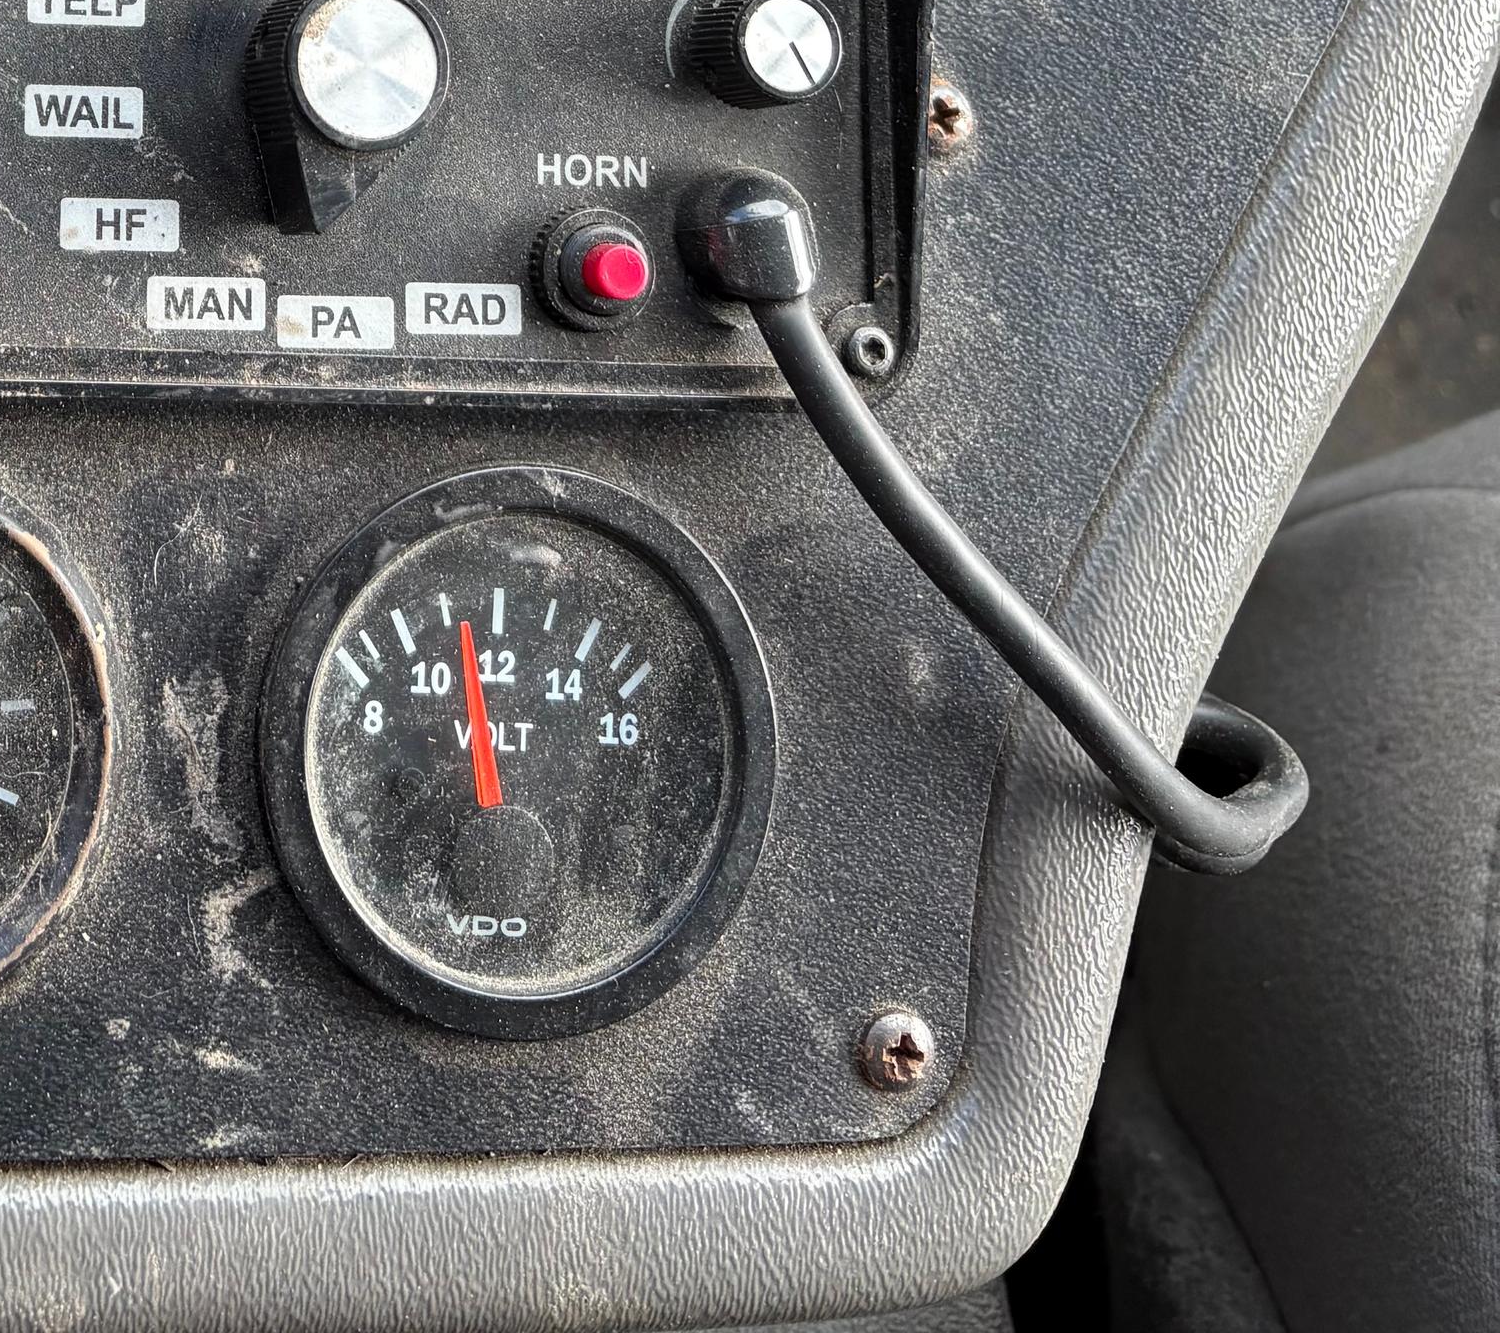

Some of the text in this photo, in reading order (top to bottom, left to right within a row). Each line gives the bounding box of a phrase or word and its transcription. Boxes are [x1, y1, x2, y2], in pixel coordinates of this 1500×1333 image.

[33, 95, 135, 131] WAIL
[536, 153, 649, 189] HORN
[94, 208, 149, 243] HF
[162, 286, 254, 323] MAN
[422, 292, 507, 327] RAD
[309, 305, 362, 341] PA
[410, 660, 451, 694] 10
[478, 649, 516, 683] 12
[545, 668, 583, 702] 14
[362, 699, 384, 734] 8
[599, 712, 639, 746] 16
[445, 913, 528, 938] VDO
